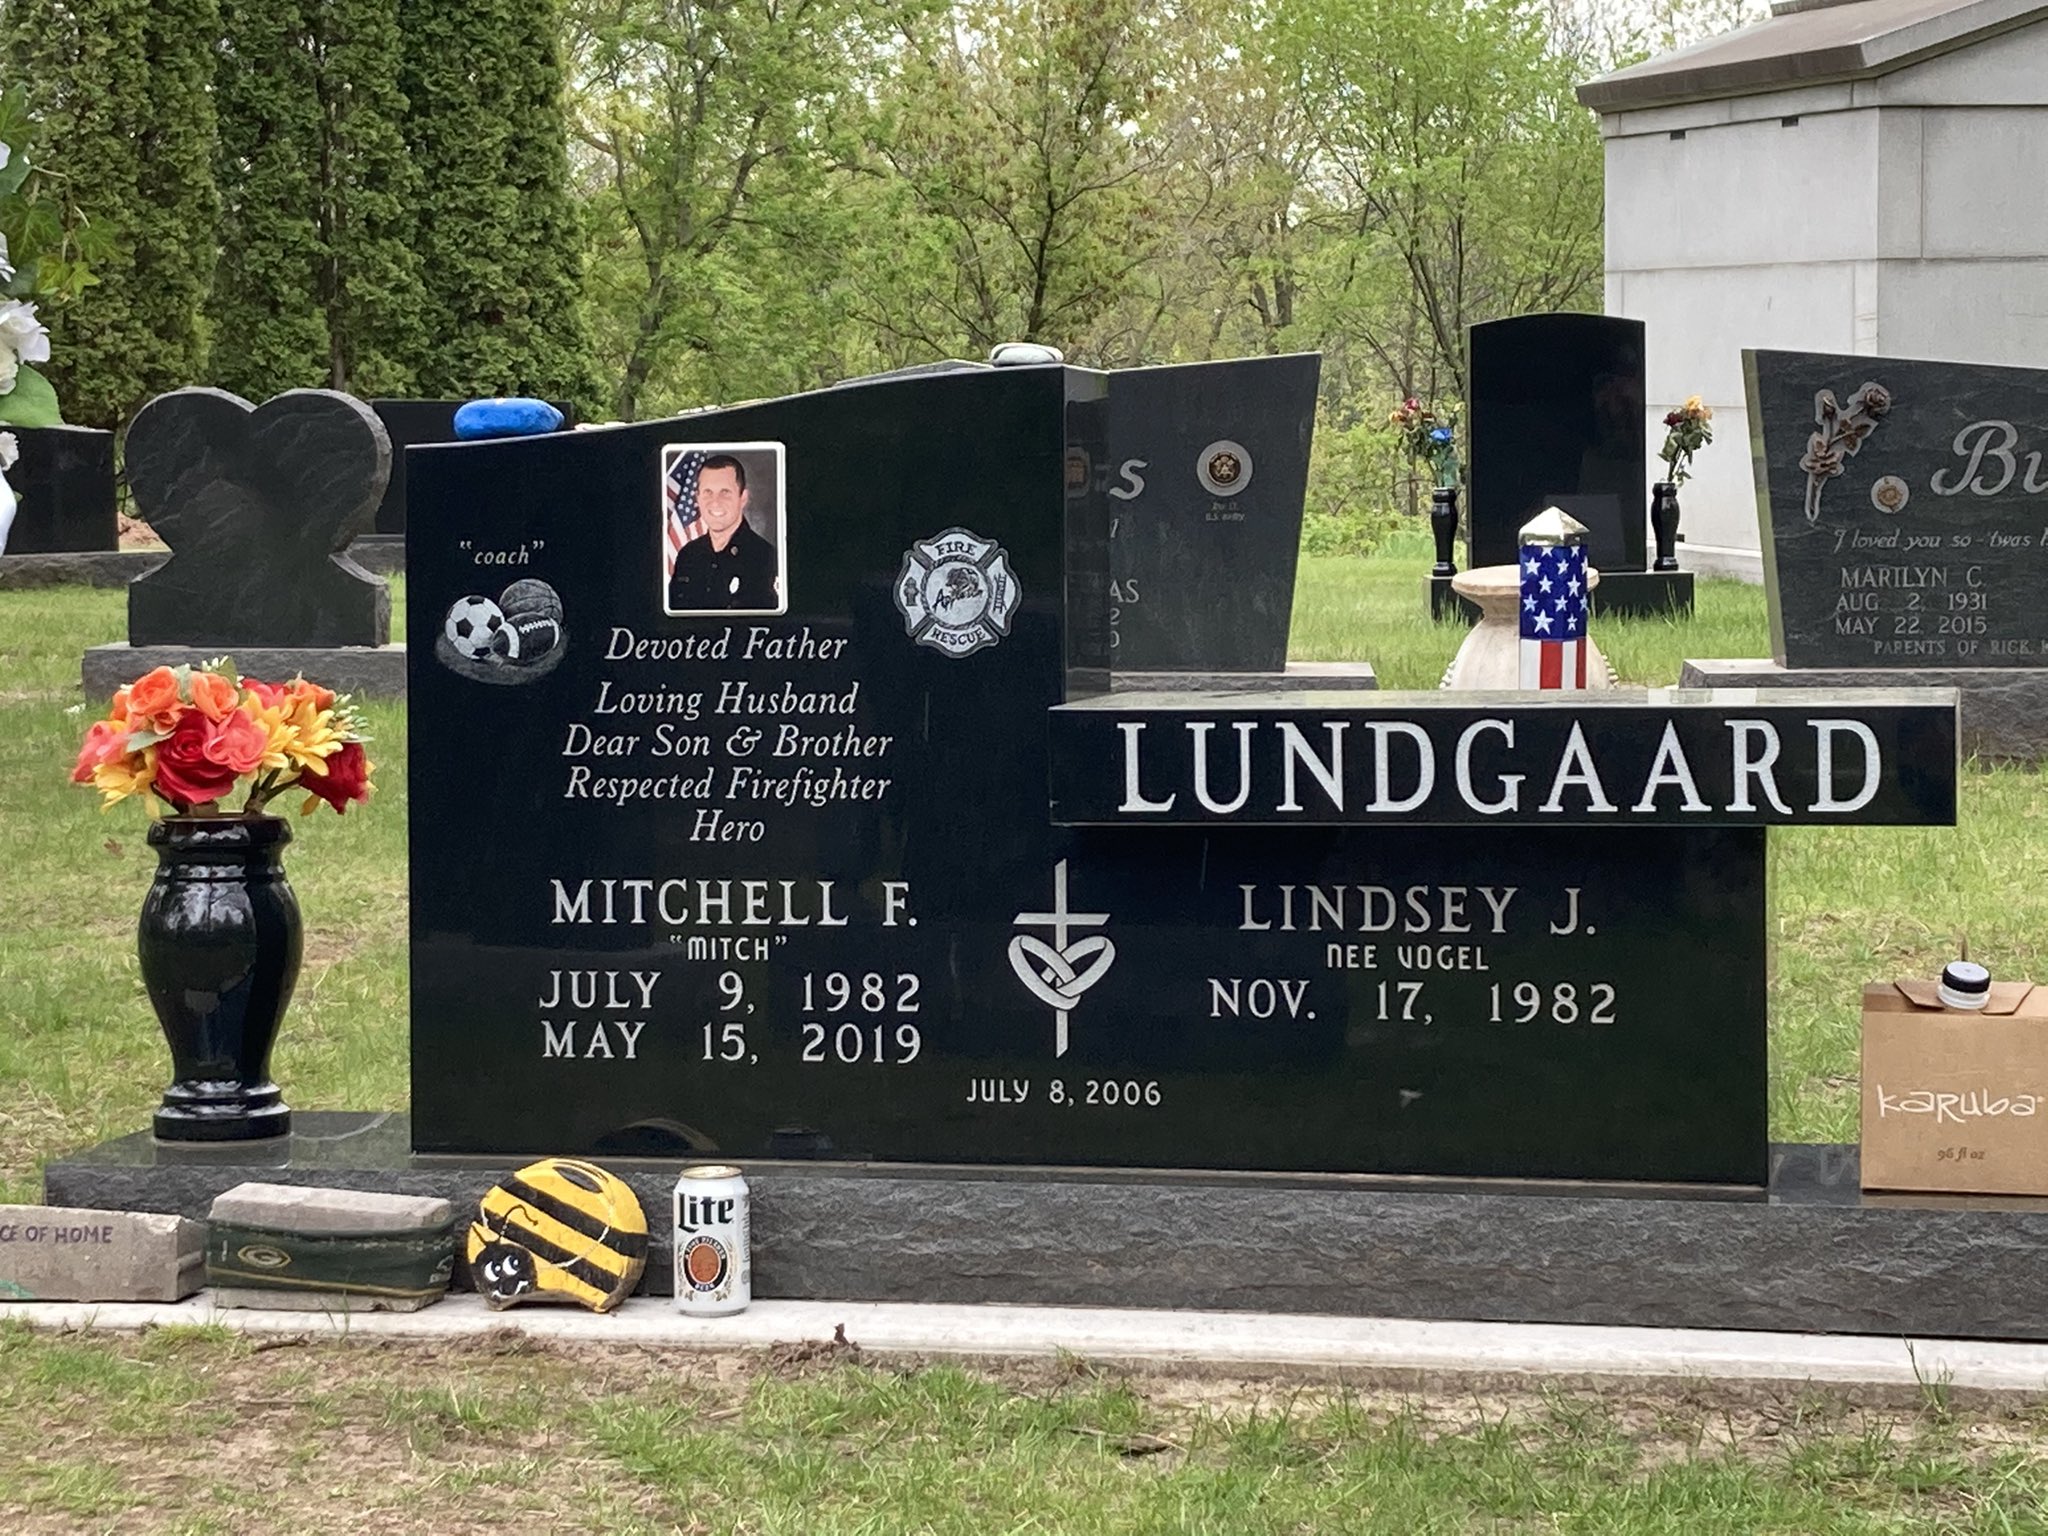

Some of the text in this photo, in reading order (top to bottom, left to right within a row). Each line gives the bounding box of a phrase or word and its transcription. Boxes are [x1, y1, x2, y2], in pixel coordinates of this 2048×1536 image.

[935, 541, 977, 556] FIRE
[1851, 528, 1900, 549] loved
[1903, 534, 1942, 551] you
[1840, 566, 1948, 588] MARILYN
[1835, 592, 1879, 612] AUG
[1948, 592, 1988, 611] 1931
[931, 627, 986, 646] RESCUE
[1835, 616, 1880, 635] MAY
[1938, 616, 1988, 635] 2015
[603, 626, 849, 660] Devoted Father
[1873, 639, 1946, 656] PARENTS
[1957, 639, 1979, 656] OF
[593, 680, 860, 720] Loving Husband
[561, 723, 894, 757] Dear Son & Brother
[1116, 718, 1882, 816] LUNDGAARD
[563, 765, 892, 808] Respected Firefighter
[689, 808, 765, 842] Hero
[550, 878, 918, 927] MITCHELL F.
[1238, 884, 1596, 936] LINDSEY J.
[1397, 944, 1490, 971] VOGEL
[538, 970, 920, 1015] JULY 9, 1982
[1207, 977, 1616, 1026] NOV. 17, 1982
[540, 1020, 921, 1065] MAY 15, 2019
[966, 1078, 1161, 1107] JULY 8, 2006
[1937, 1146, 1985, 1162] 96 fl oz
[678, 1192, 734, 1233] Lite
[25, 1226, 48, 1243] OF
[55, 1225, 114, 1243] HOME
